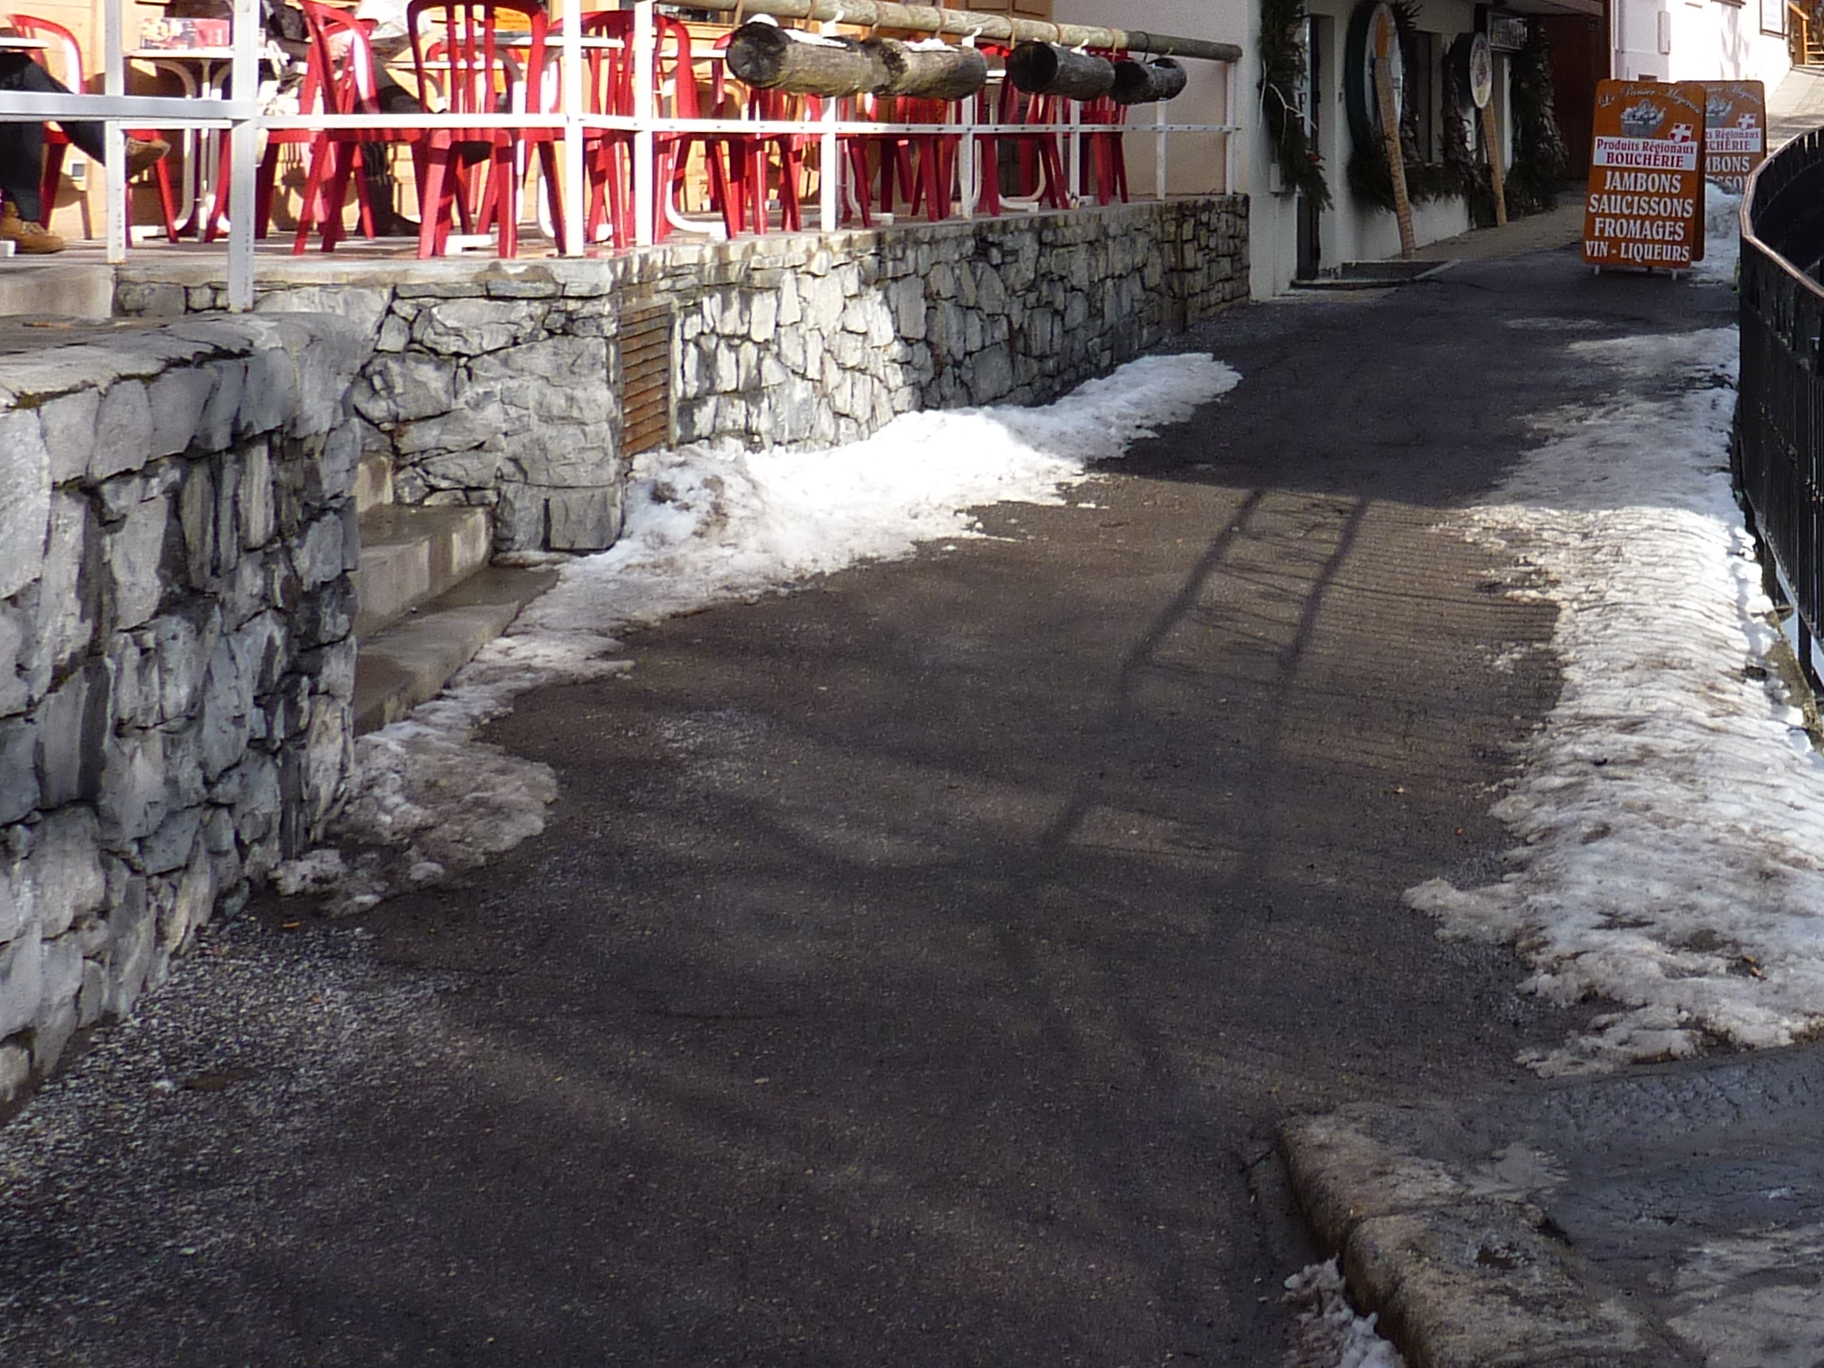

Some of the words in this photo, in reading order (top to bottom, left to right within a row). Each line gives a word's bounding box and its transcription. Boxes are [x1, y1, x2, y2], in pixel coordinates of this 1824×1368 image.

[1597, 139, 1639, 152] Produits
[1642, 141, 1695, 155] Régionaux
[1705, 140, 1751, 151] CHERIE
[1606, 151, 1684, 168] BOUCHERIE
[1604, 171, 1682, 194] JAMBONS
[1589, 193, 1694, 218] SAUCISSONS
[1594, 217, 1685, 241] FROMAGES
[1585, 240, 1608, 257] VIN
[1620, 244, 1691, 262] LIQUEURS
